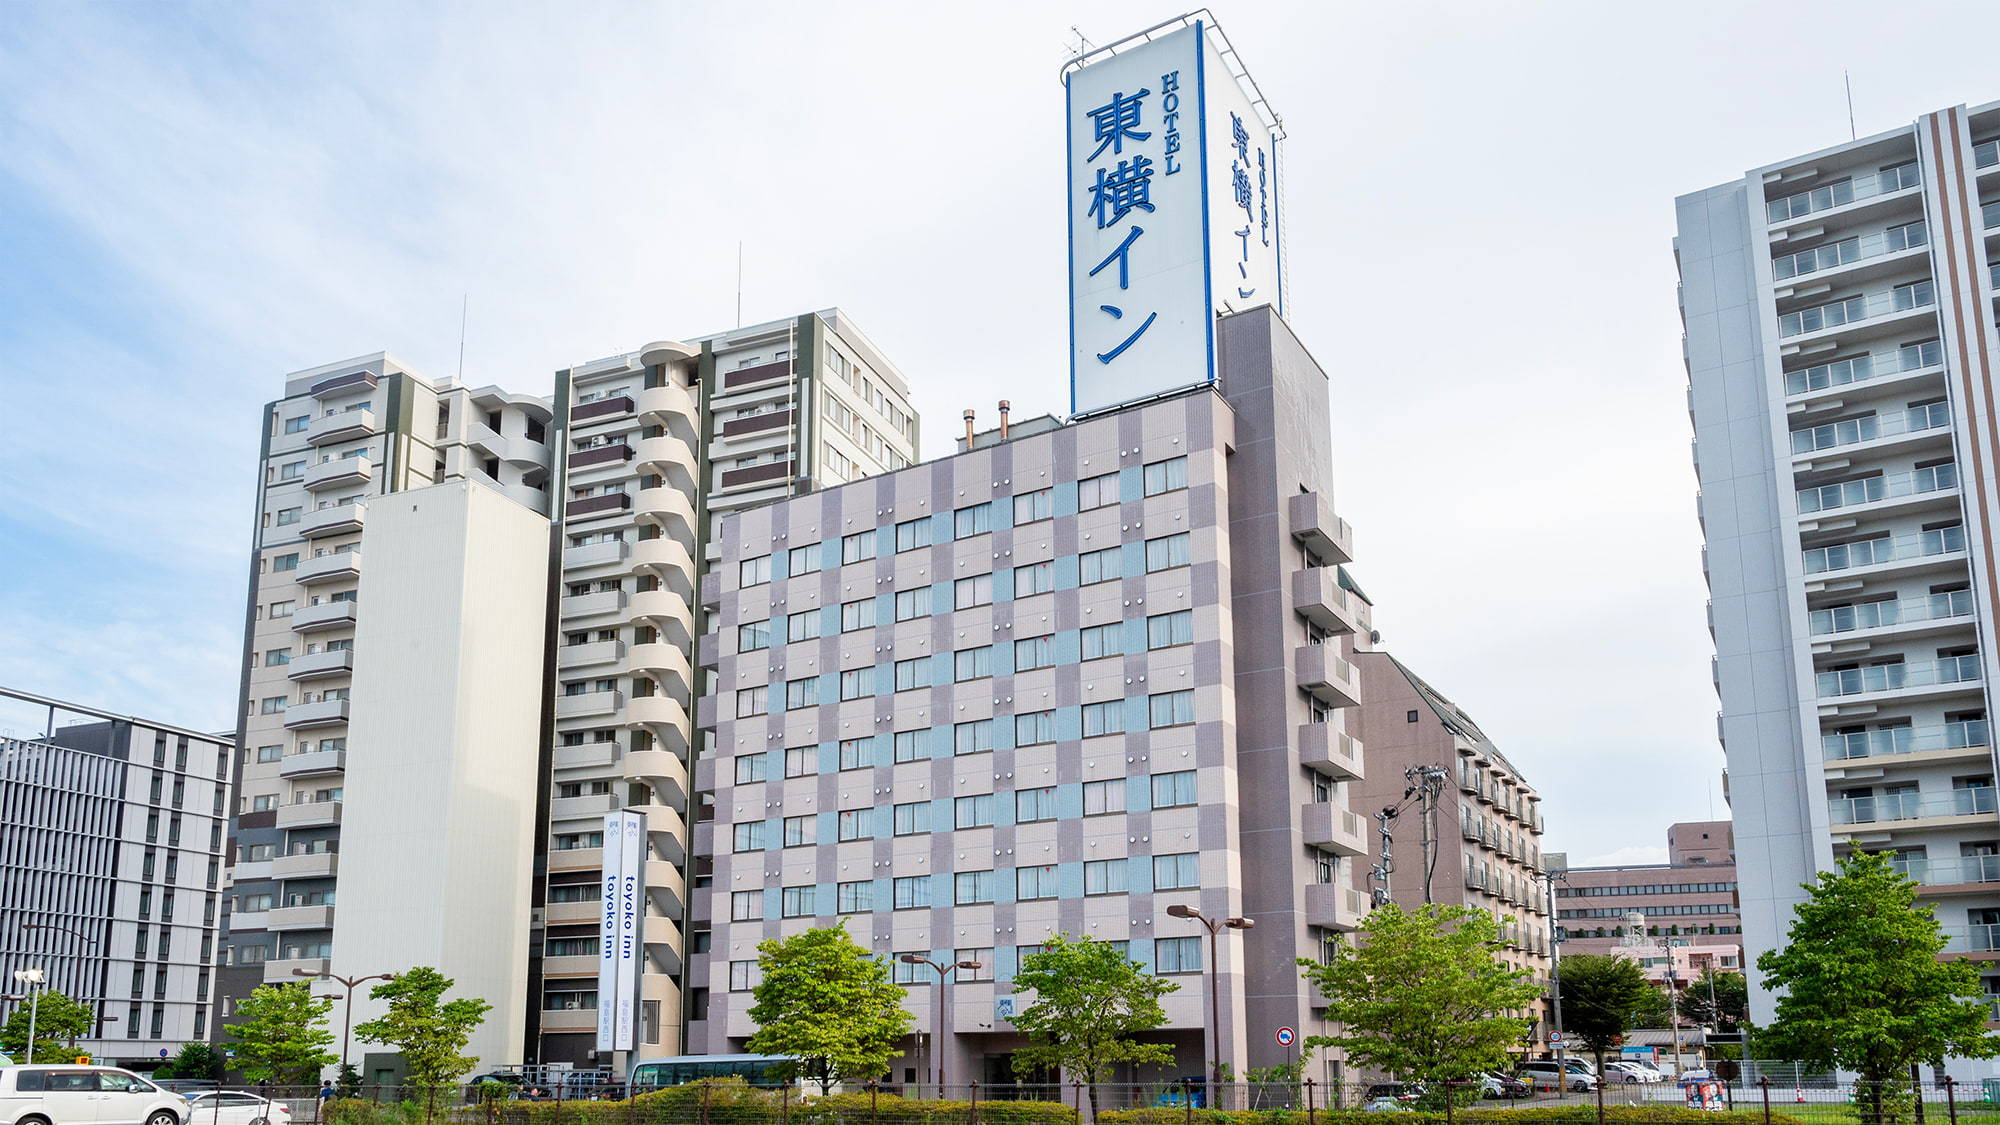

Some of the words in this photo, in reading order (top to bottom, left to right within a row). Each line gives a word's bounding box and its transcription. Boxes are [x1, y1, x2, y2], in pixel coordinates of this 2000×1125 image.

[1160, 70, 1181, 176] HOTEL
[1086, 87, 1158, 365] 東横イン
[1229, 110, 1256, 299] 東横イン
[1257, 146, 1269, 248] HOTEL
[605, 875, 617, 930] toyoko
[623, 875, 636, 930] toyoko
[605, 935, 615, 959] inn
[623, 935, 634, 959] inn
